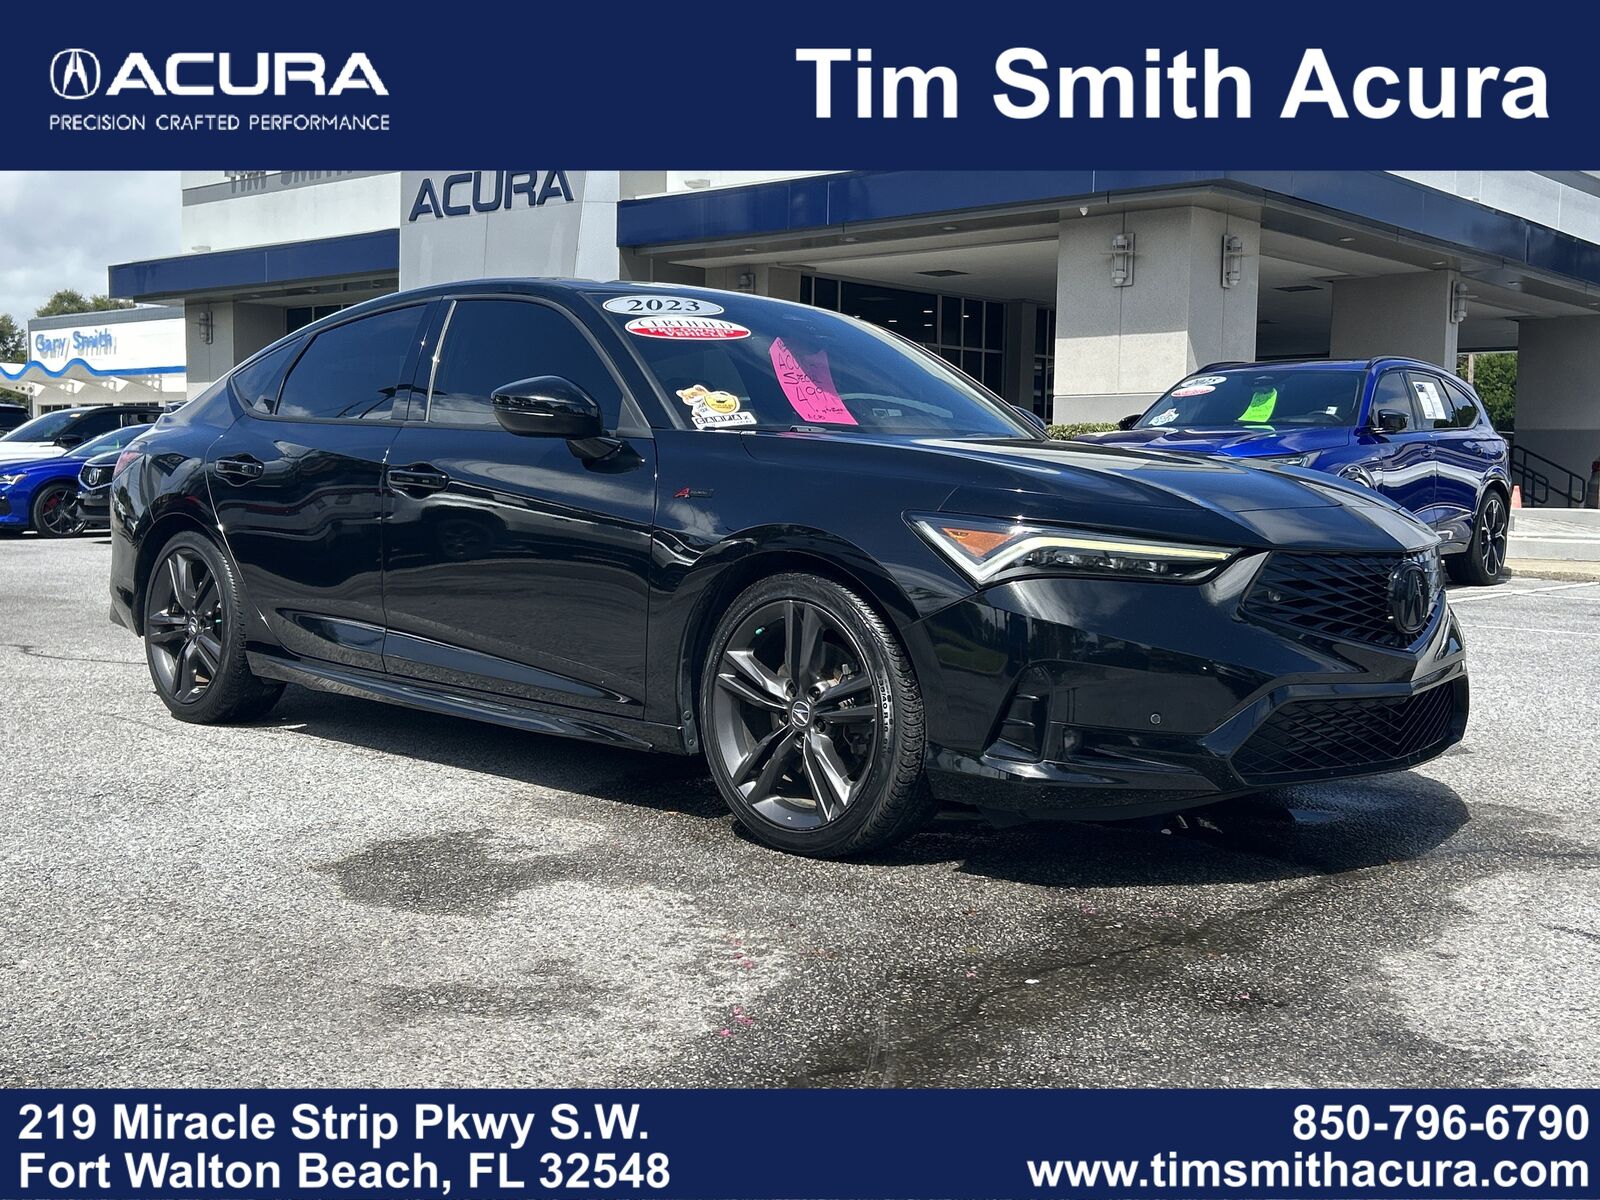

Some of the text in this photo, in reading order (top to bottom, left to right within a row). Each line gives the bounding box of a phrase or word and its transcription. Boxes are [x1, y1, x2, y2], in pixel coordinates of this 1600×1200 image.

[408, 170, 574, 222] ACURA
[626, 299, 700, 312] 2023
[637, 319, 734, 330] CERTIFIED
[35, 328, 113, 357] Gary Smith
